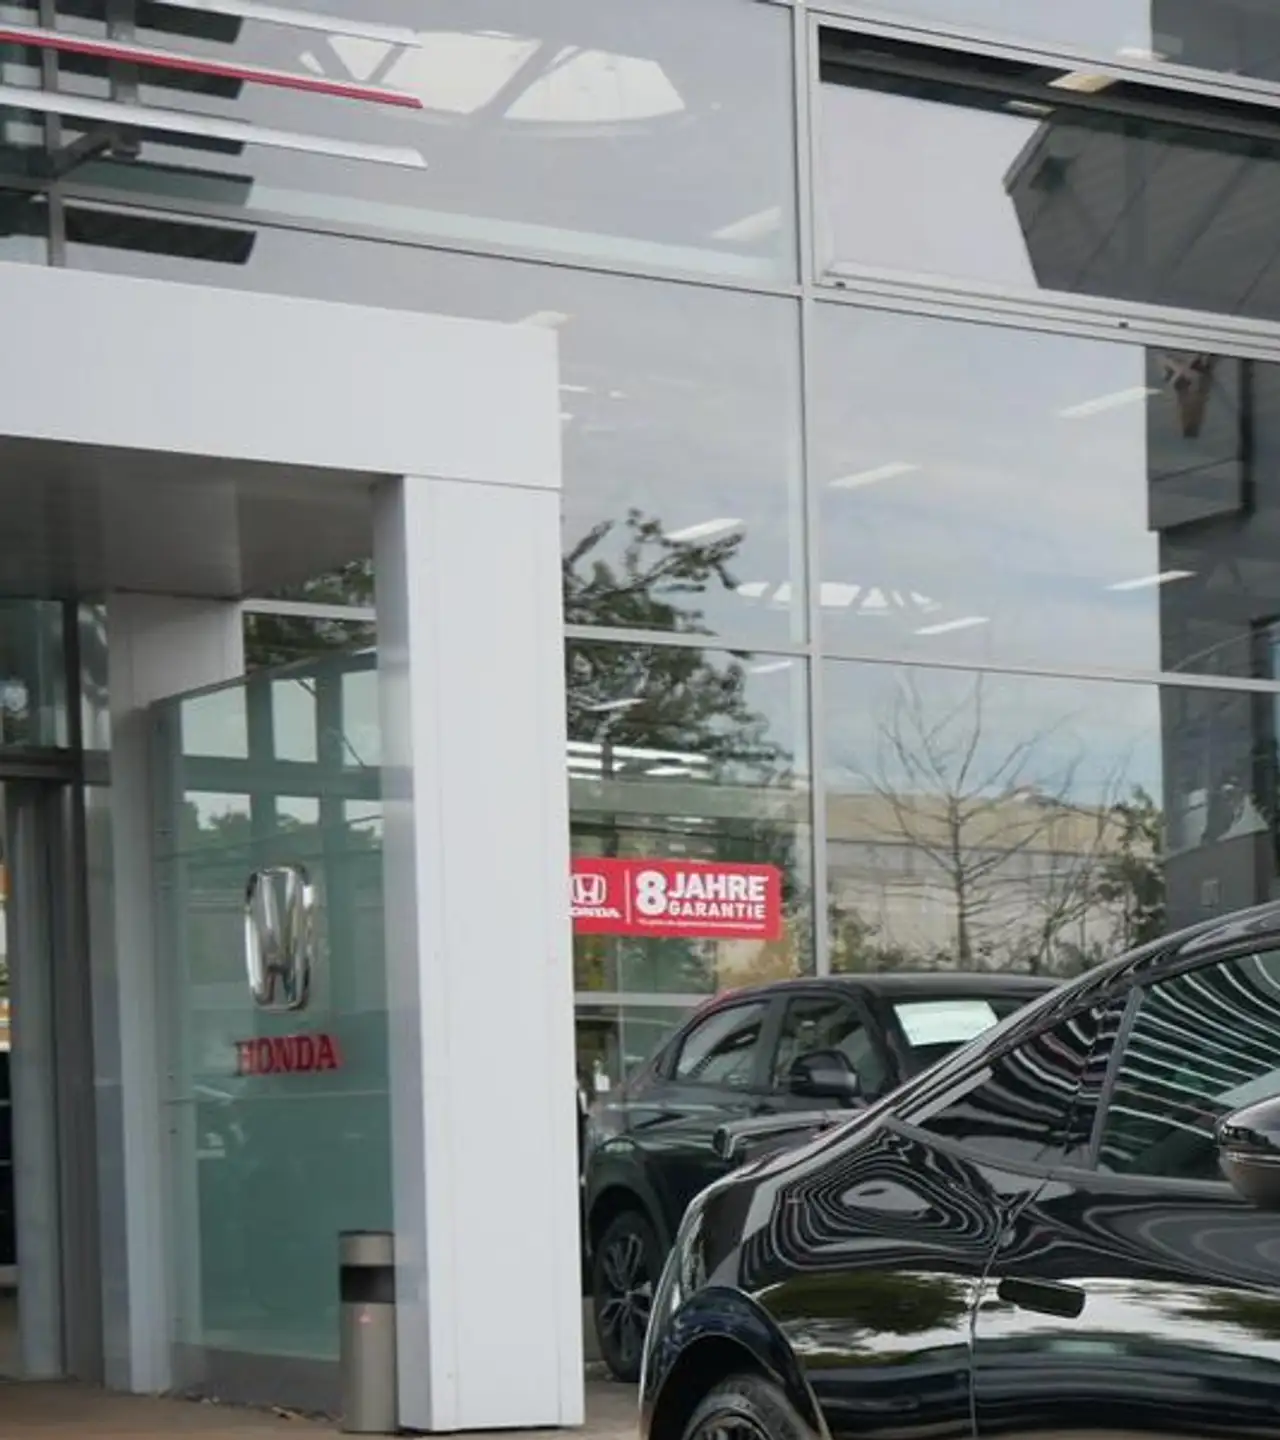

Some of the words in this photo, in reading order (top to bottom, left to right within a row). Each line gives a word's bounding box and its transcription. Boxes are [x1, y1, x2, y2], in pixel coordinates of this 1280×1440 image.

[636, 869, 667, 916] 8
[668, 873, 769, 901] JAHRE
[668, 901, 766, 919] GARANTIE
[234, 1034, 340, 1076] HONDA
